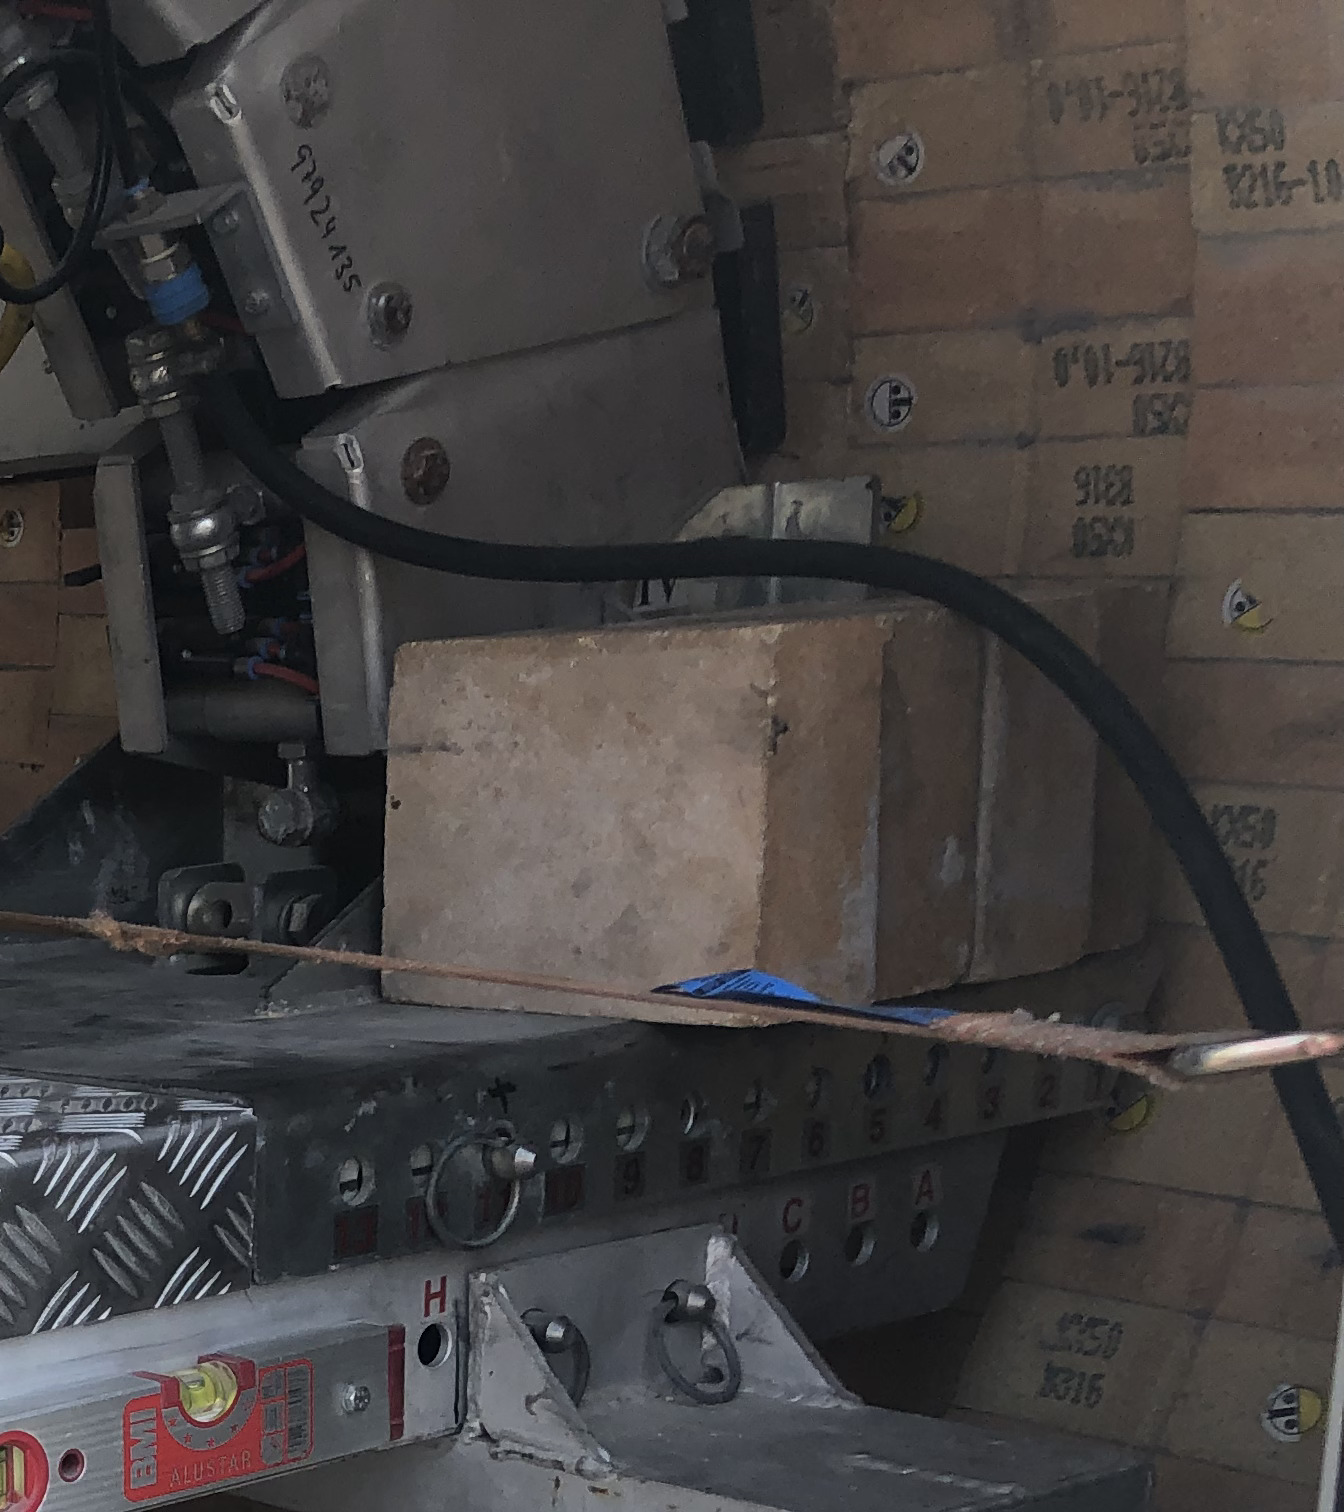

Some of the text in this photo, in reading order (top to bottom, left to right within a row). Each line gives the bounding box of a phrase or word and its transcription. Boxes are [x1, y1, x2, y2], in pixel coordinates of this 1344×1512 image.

[852, 1184, 870, 1218] B
[915, 1169, 934, 1206] A
[782, 1197, 803, 1234] C
[424, 1275, 447, 1318] H
[130, 1407, 158, 1490] BMI
[169, 1450, 252, 1488] ALUSTAR
